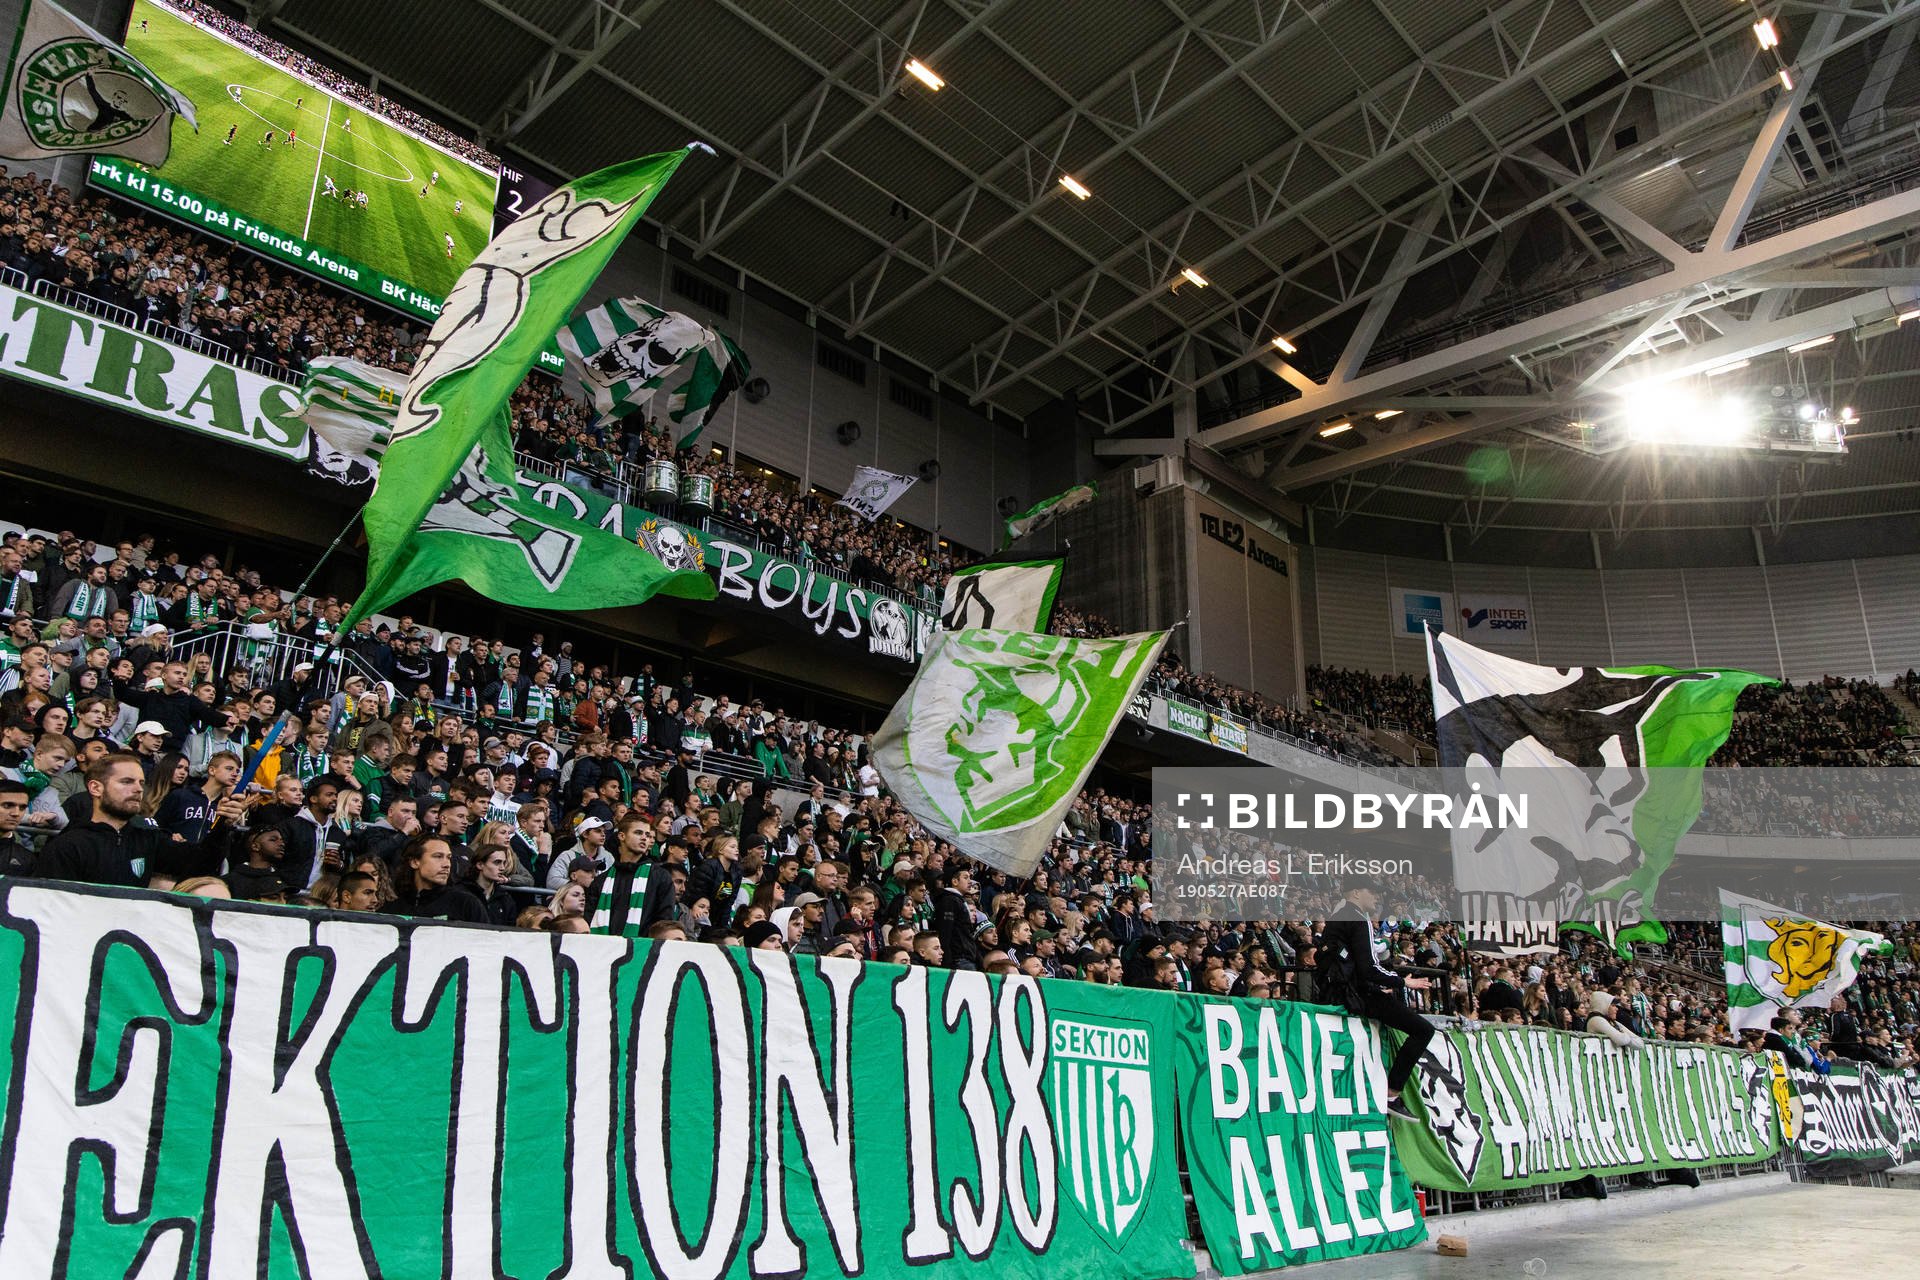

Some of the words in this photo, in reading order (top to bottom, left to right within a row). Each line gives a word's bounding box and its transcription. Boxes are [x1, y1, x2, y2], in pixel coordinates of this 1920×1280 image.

[502, 166, 523, 184] HIF
[126, 172, 145, 192] kl
[151, 183, 203, 216] 15.00
[204, 206, 230, 228] på
[232, 218, 303, 258] Friends
[307, 250, 360, 281] Arena
[507, 190, 522, 216] 2
[381, 279, 406, 301] BK
[409, 291, 444, 315] Häc
[0, 295, 308, 448] TRAS
[1200, 512, 1246, 554] TELE2
[1247, 538, 1289, 578] Arena
[708, 541, 867, 639] BOYS
[1488, 608, 1527, 620] INTER
[1489, 619, 1528, 631] SPORT
[1169, 707, 1205, 732] NACKA
[1053, 1023, 1149, 1062] SEKTION
[1203, 1003, 1389, 1120] BAJEN
[893, 966, 1060, 1263] 138
[1229, 1130, 1416, 1260] ALLEZ
